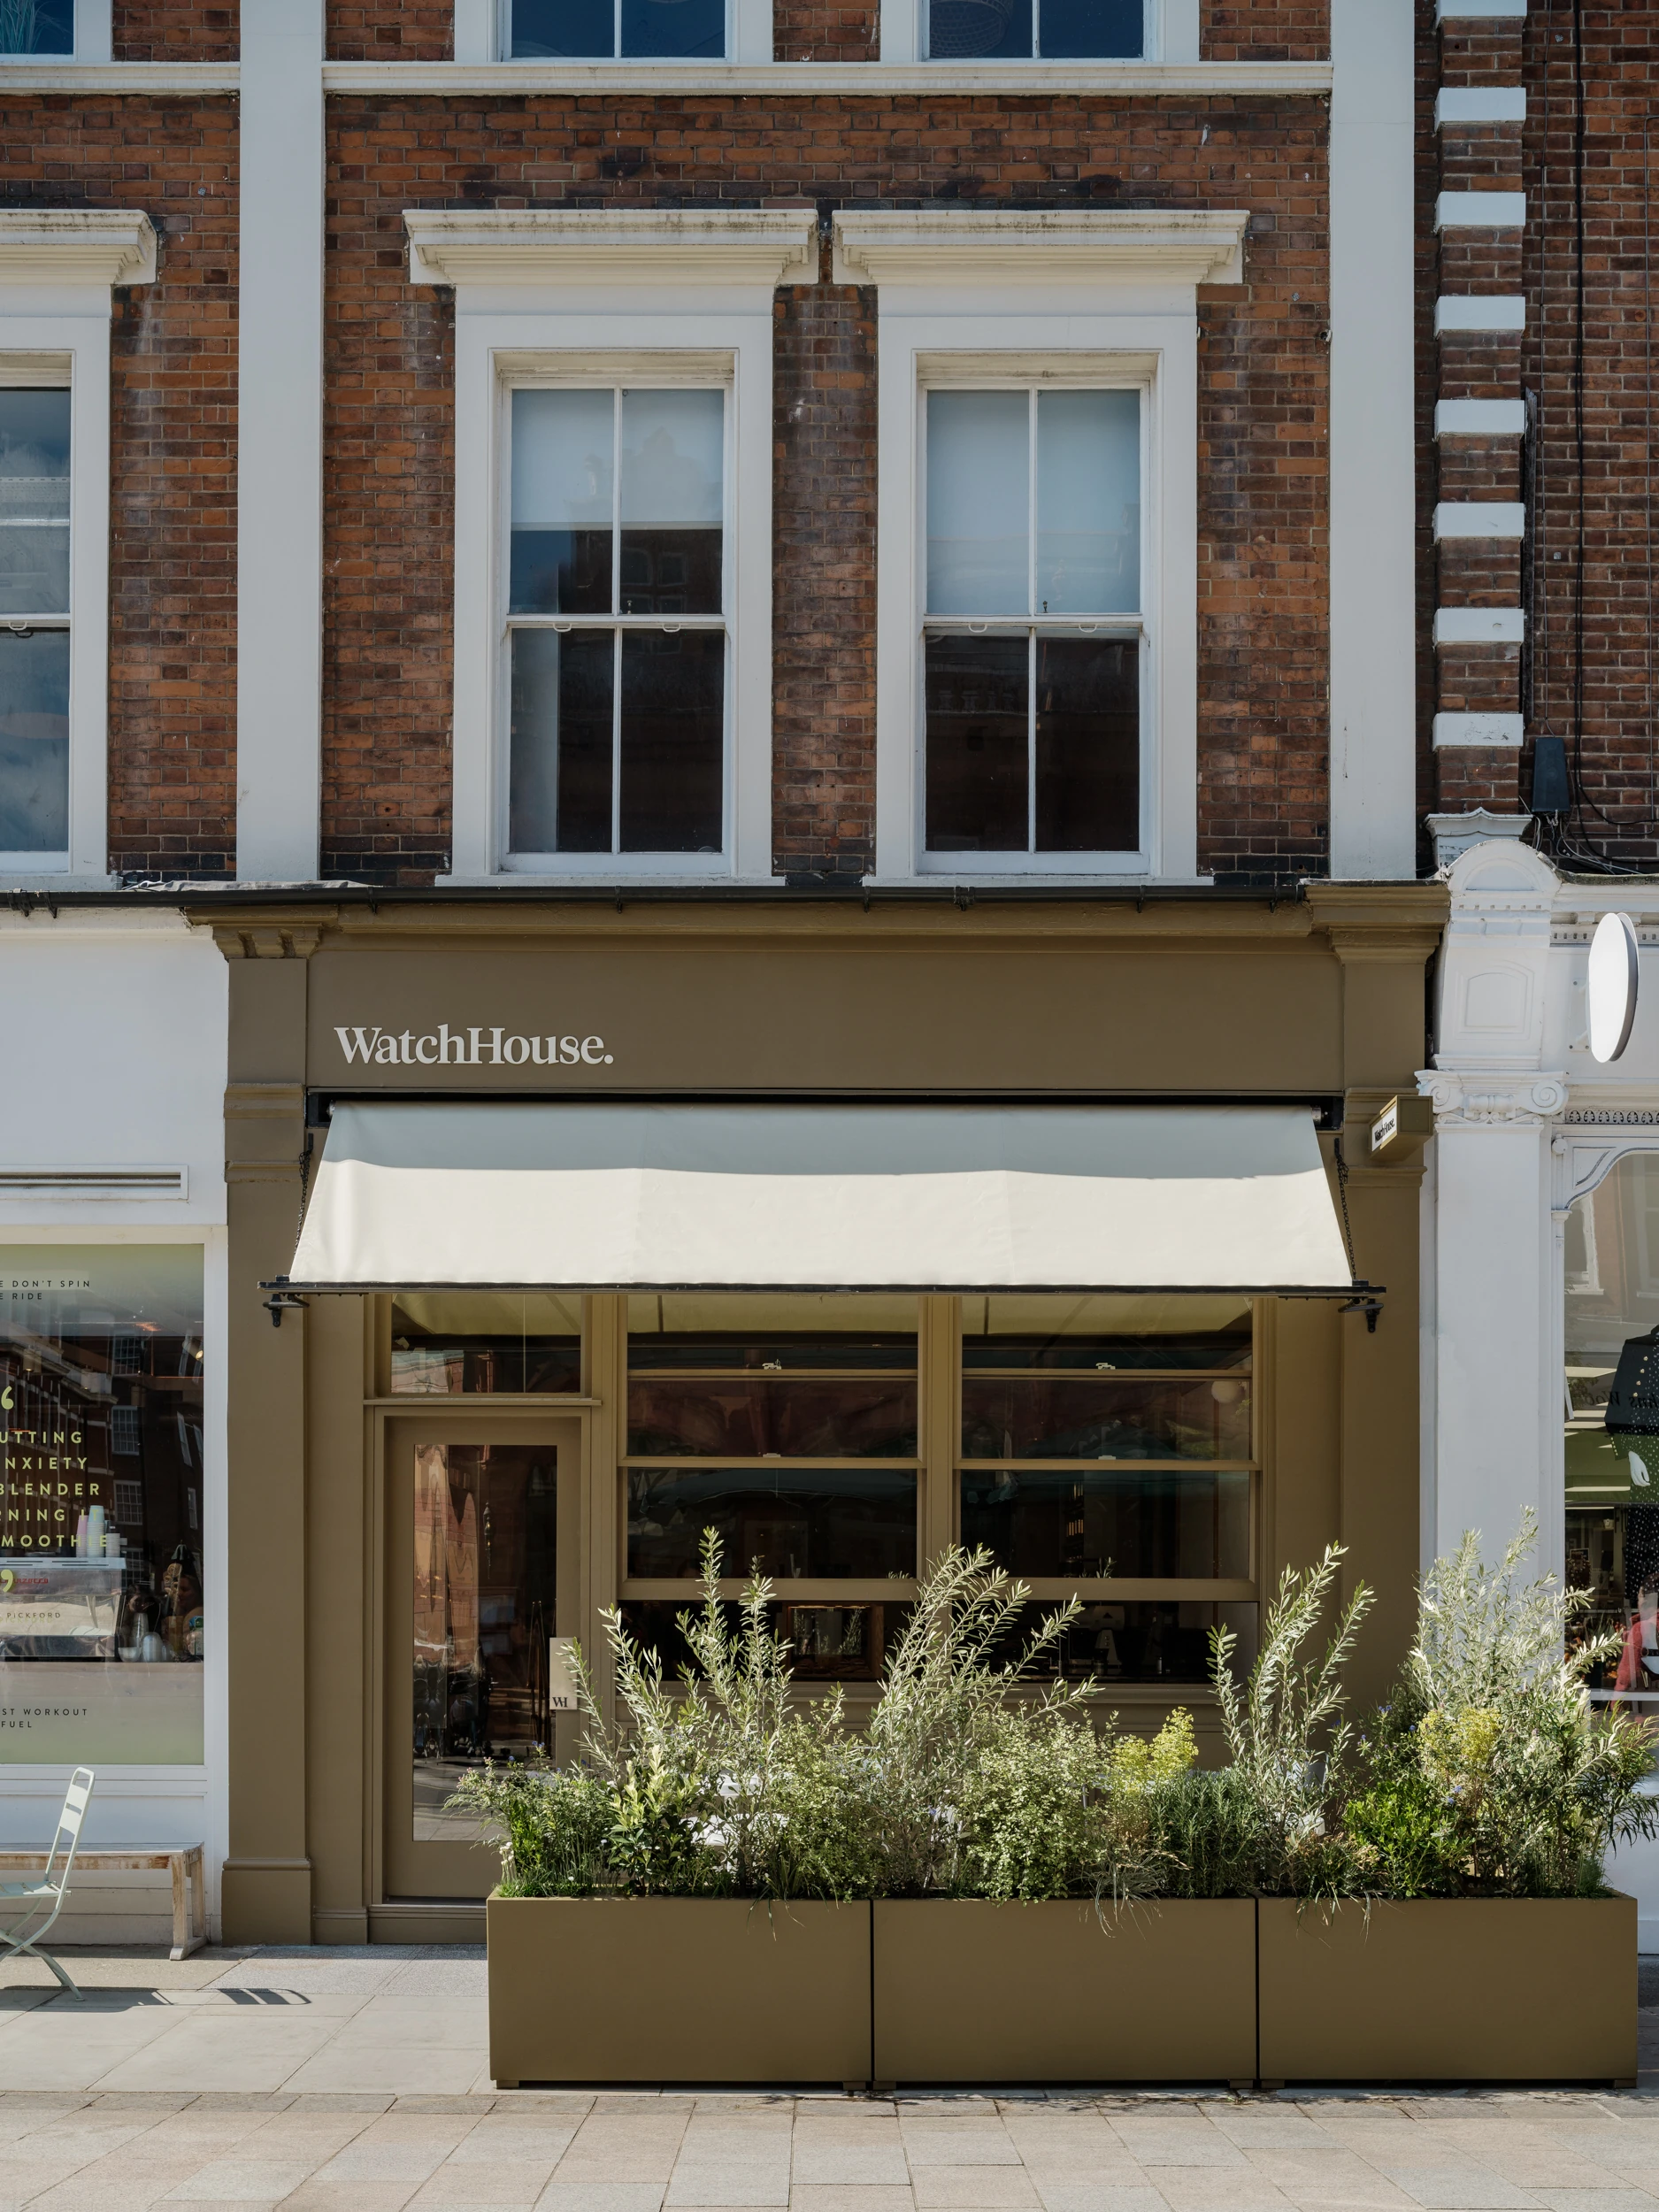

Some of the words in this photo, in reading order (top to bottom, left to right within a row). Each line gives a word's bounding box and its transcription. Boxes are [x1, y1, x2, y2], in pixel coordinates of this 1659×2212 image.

[334, 1024, 614, 1064] WatchHouse.
[5, 1457, 87, 1470] NXIETY
[0, 1509, 65, 1521] NING
[81, 1509, 99, 1521] IT
